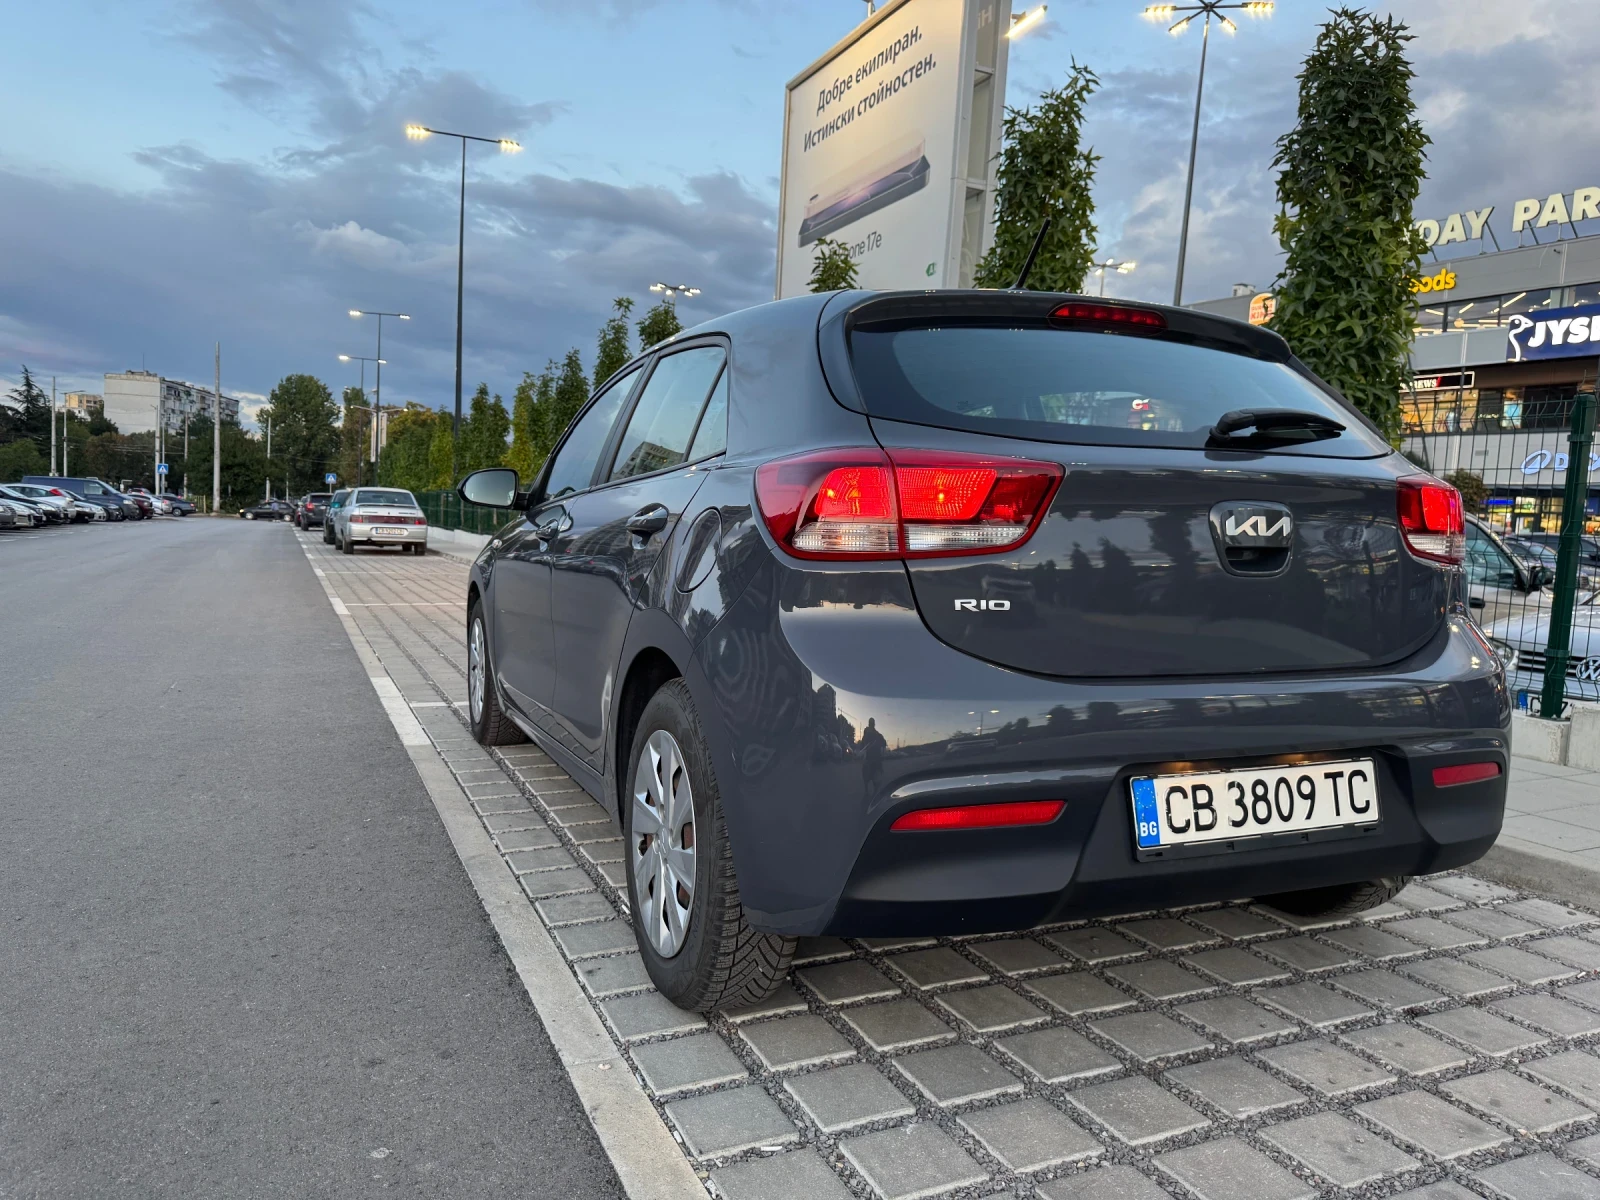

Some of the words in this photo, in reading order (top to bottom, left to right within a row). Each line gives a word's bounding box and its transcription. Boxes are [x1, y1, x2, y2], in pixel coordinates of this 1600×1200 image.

[816, 73, 853, 117] Добре
[855, 25, 922, 84] екипиран.
[803, 109, 855, 153] Истински
[857, 53, 937, 117] стойностен.
[866, 231, 882, 252] 17e
[1405, 206, 1495, 248] DAY
[1226, 515, 1291, 537] KIA
[954, 598, 1011, 612] RIO
[1139, 820, 1158, 837] BG
[1164, 783, 1218, 834] CB
[1227, 774, 1316, 828] 3809
[1323, 769, 1371, 817] TC
